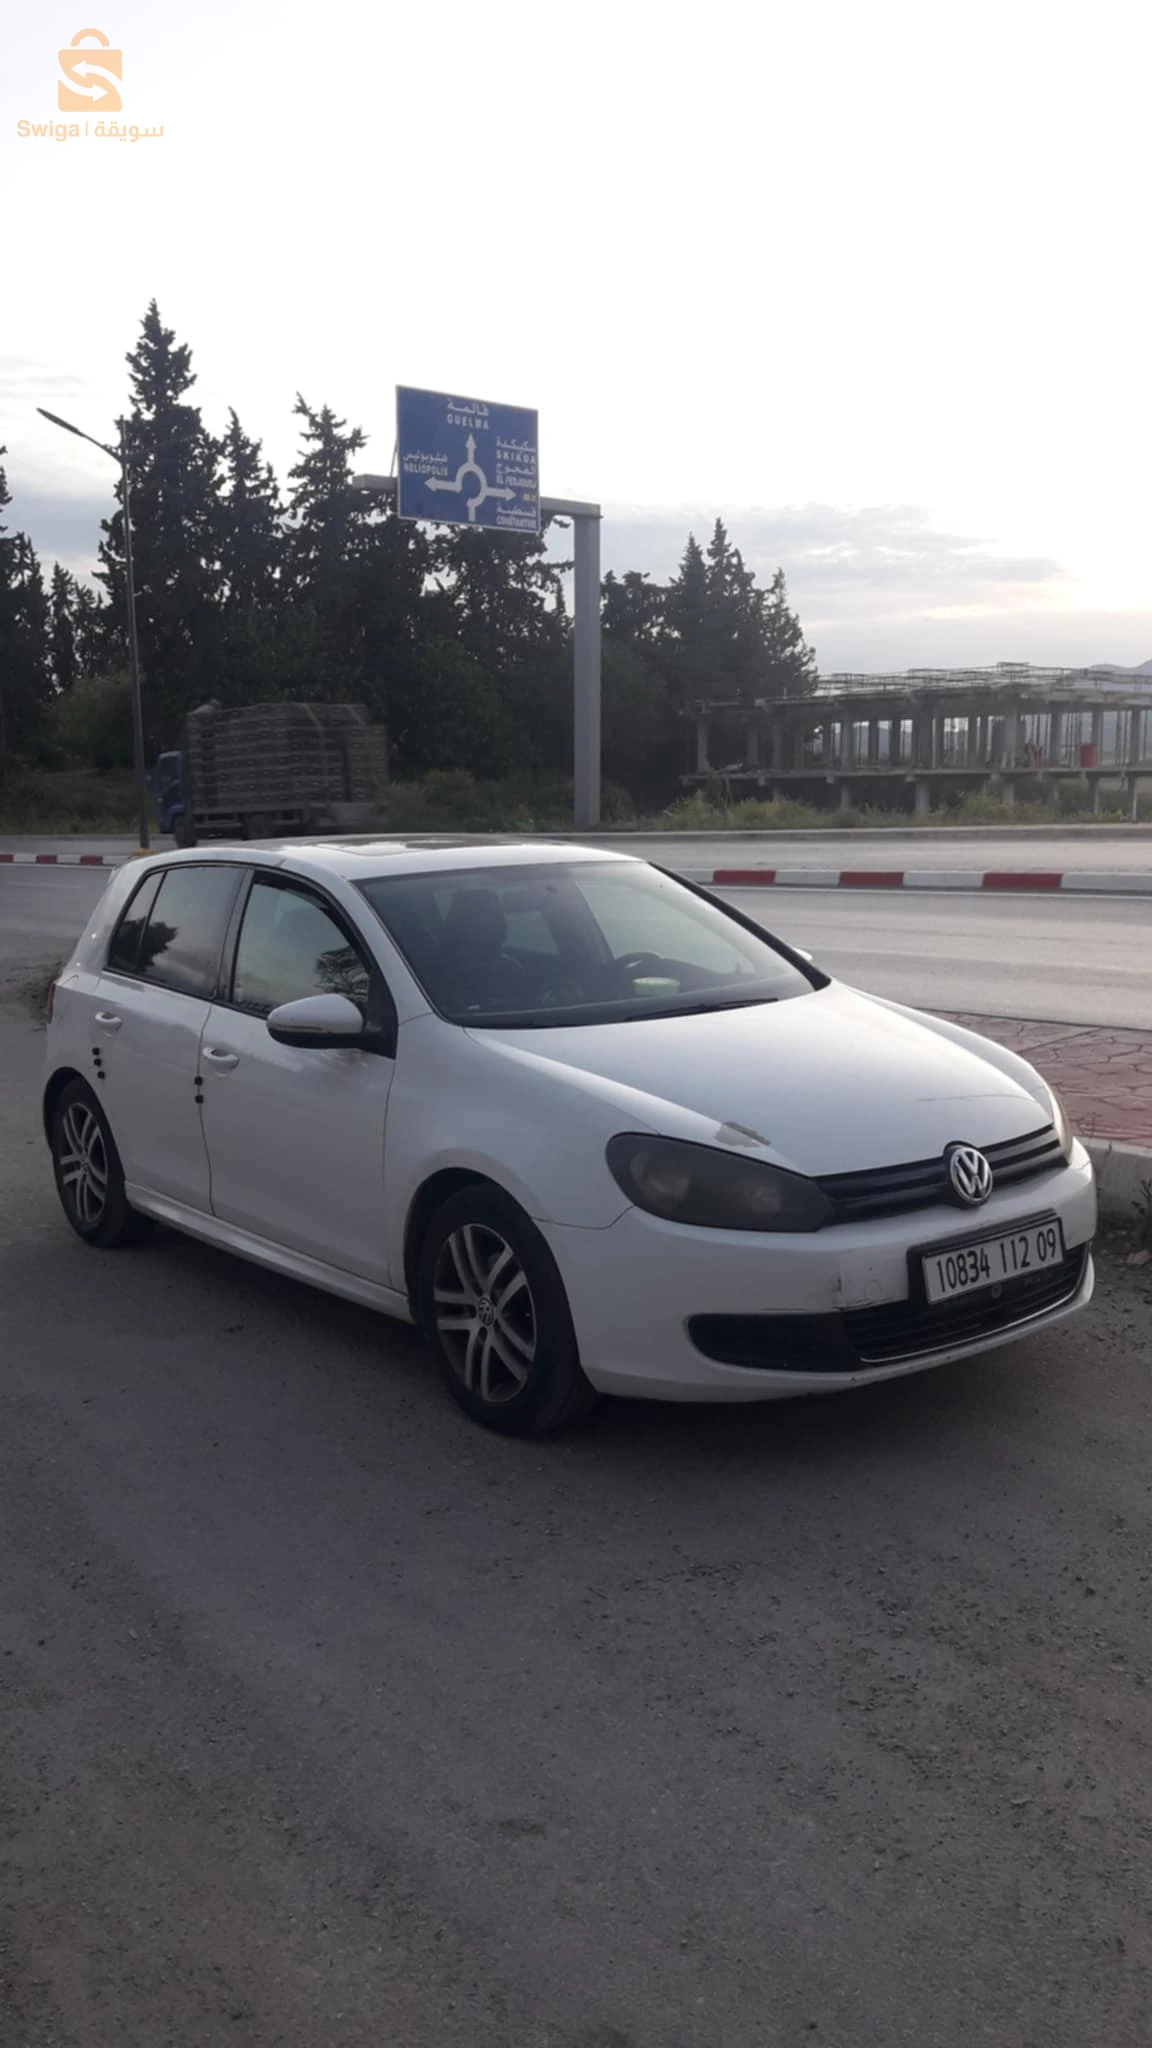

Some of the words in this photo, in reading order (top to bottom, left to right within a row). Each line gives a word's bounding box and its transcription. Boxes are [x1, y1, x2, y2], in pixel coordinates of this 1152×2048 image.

[447, 413, 489, 430] GUELMA
[496, 450, 536, 464] SKIKDA
[936, 1247, 991, 1293] 10834
[1000, 1236, 1031, 1273] 112
[1036, 1228, 1056, 1262] 09
